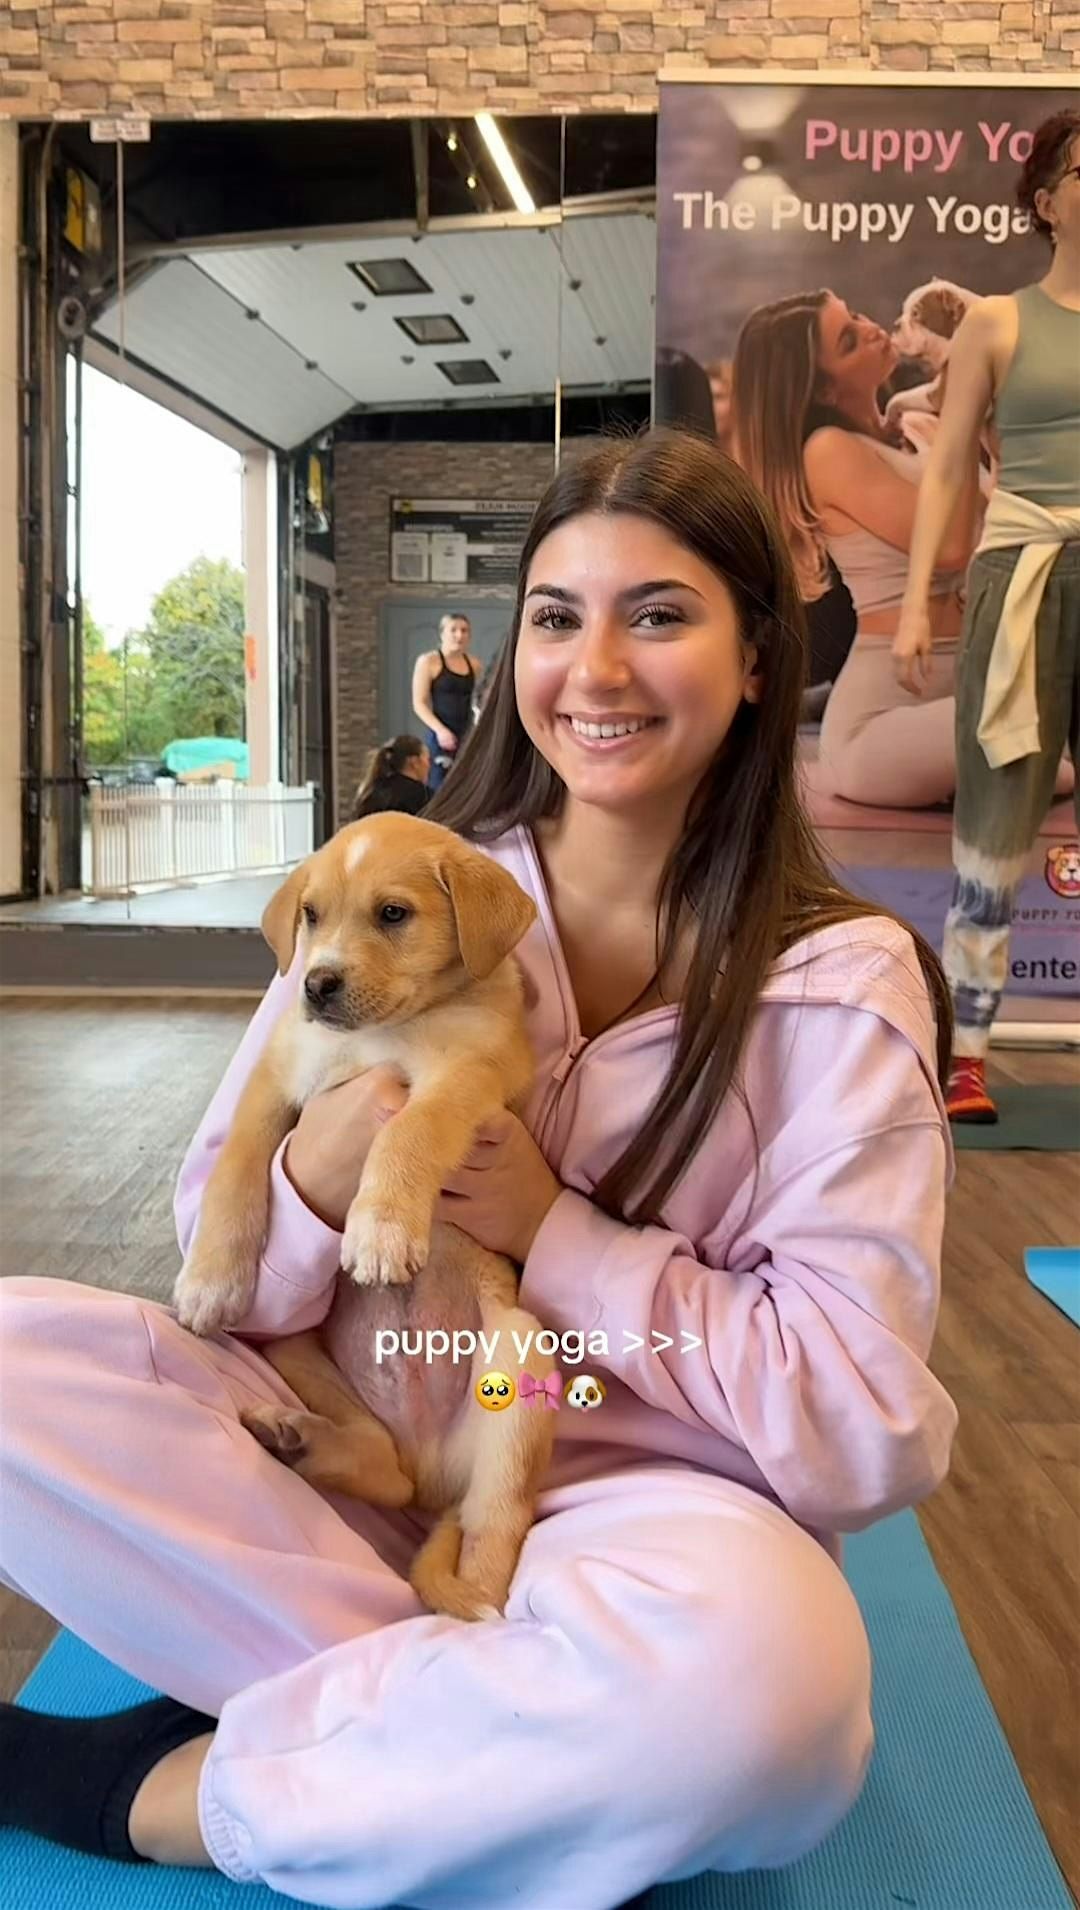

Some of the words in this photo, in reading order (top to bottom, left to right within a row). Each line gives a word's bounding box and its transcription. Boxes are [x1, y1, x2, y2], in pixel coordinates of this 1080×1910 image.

[805, 119, 963, 172] Puppy
[673, 191, 756, 230] The
[772, 193, 914, 242] Puppy
[1011, 908, 1059, 920] PUPPY
